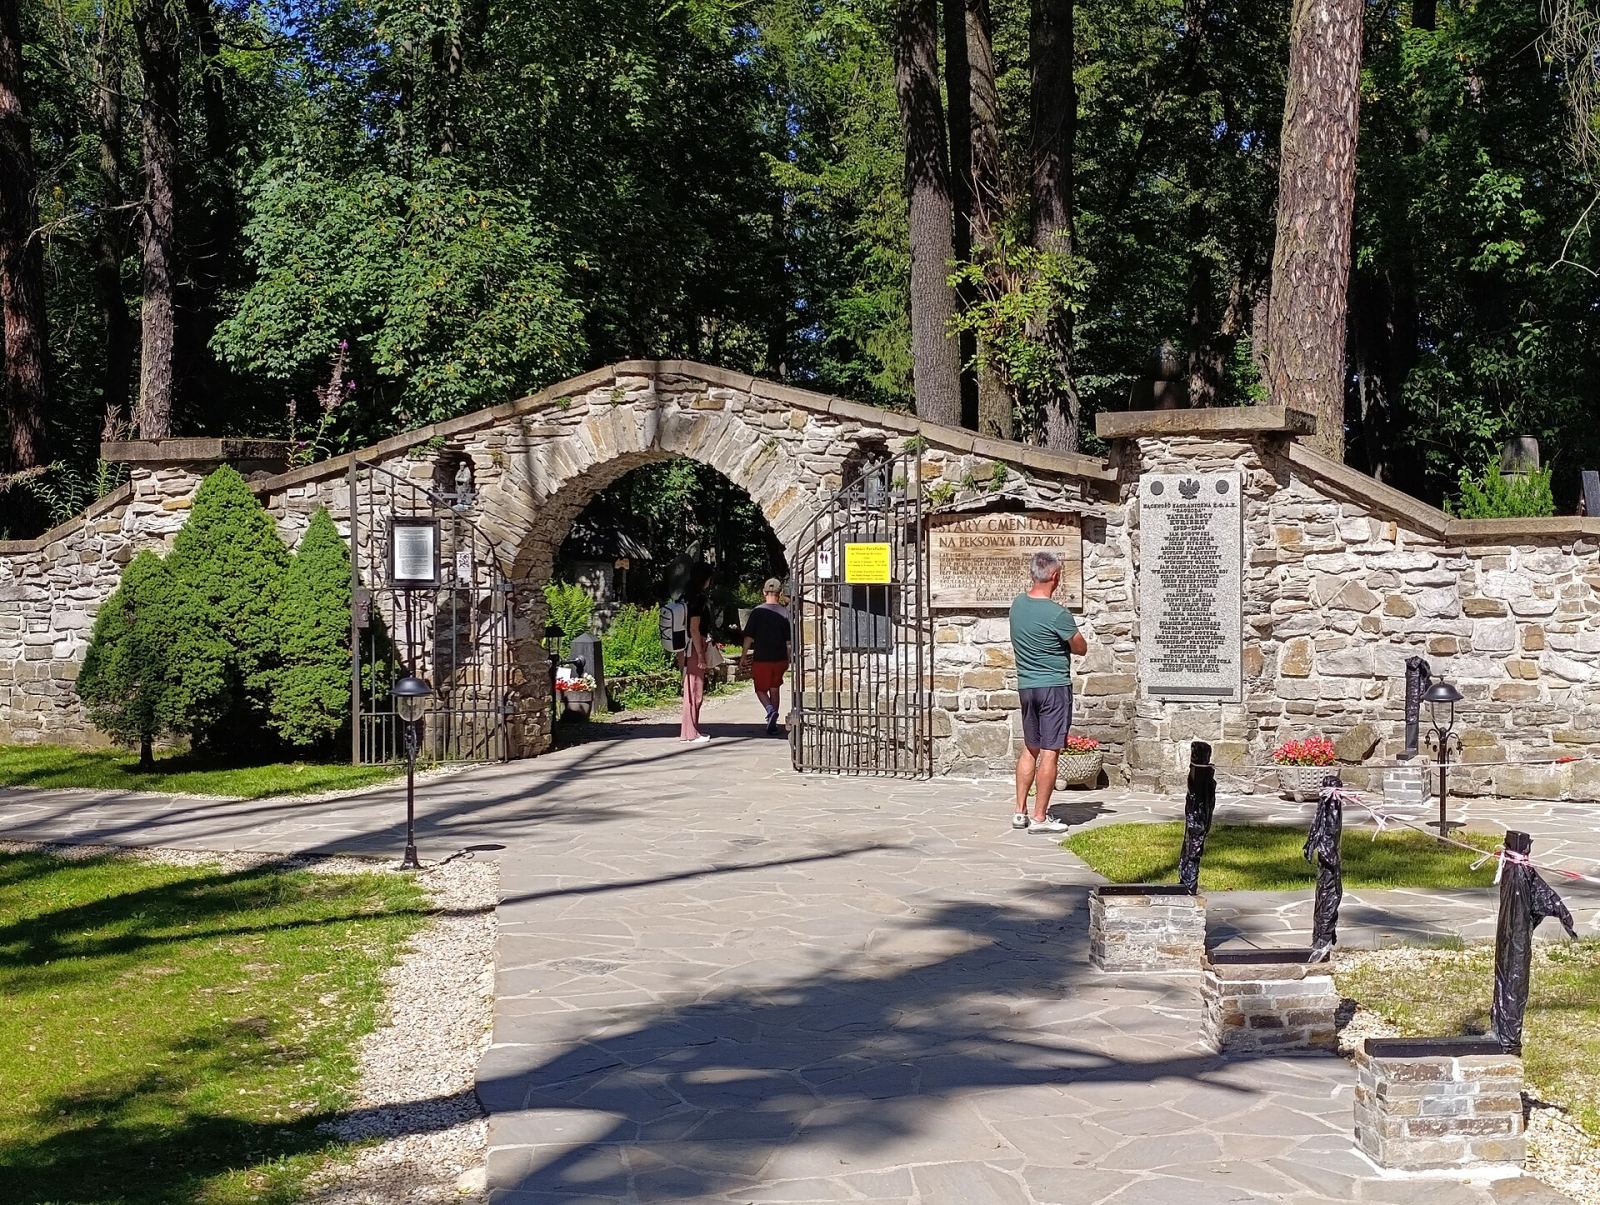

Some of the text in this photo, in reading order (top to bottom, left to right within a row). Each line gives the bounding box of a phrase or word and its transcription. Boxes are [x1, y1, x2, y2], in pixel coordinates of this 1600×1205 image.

[939, 518, 1065, 532] STARY CMENTARZ
[939, 537, 956, 547] NA
[1020, 536, 1065, 546] BRZYZKU
